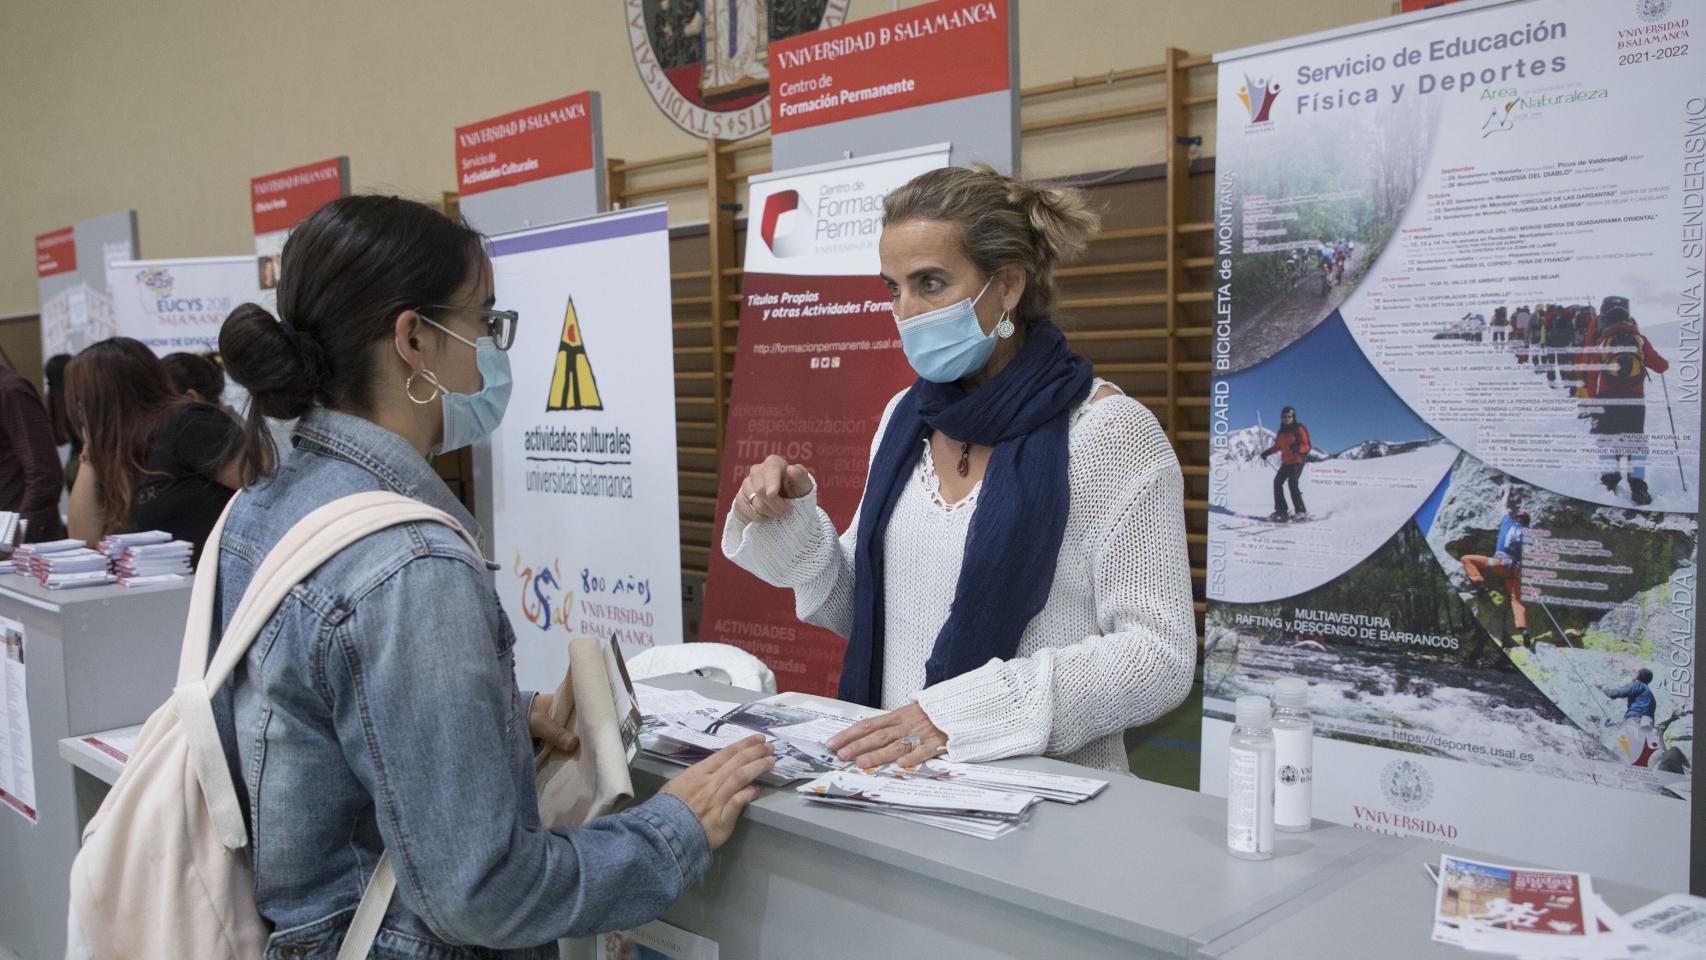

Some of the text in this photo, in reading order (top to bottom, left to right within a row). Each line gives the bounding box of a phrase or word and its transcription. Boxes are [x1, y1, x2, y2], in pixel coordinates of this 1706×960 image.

[894, 2, 996, 43] SALAMANCA
[1297, 19, 1567, 85] Servicio de Educación
[1619, 44, 1689, 66] 2021-2022
[779, 73, 833, 97] Centro de
[779, 78, 915, 117] Formación Permanente
[1297, 87, 1377, 114] Física
[1391, 83, 1404, 103] y
[1418, 56, 1567, 95] Deportes
[1520, 89, 1608, 109] Naturaleza
[527, 104, 586, 130] SALAMANCA
[462, 152, 496, 170] Servicio de
[463, 158, 539, 185] Actividades Culturales
[820, 181, 864, 196] Centro de
[1528, 172, 1541, 180] DEL
[1682, 97, 1706, 259] SENDERISMO
[1218, 260, 1232, 281] de
[156, 297, 203, 313] EUCYS
[748, 290, 820, 306] Títulos Propios
[762, 308, 770, 321] y
[772, 306, 800, 318] otras
[802, 302, 861, 317] Actividades
[1216, 280, 1232, 370] BICICLETA
[1676, 284, 1699, 404] MONTAÑA
[747, 416, 867, 436] especialización
[1651, 433, 1681, 441] NATURAL
[525, 425, 631, 455] actividades culturales
[737, 435, 814, 461] TÍTULOS
[1213, 380, 1230, 509] SNOWBOARD
[526, 464, 632, 499] universidad salamanca
[581, 568, 606, 594] 800
[714, 619, 797, 641] ACTIVIDADES
[1235, 613, 1459, 649] RAFTING y DESCENSO DE BARRANCOS
[1295, 607, 1391, 629] MULTIAVENTURA
[1671, 573, 1693, 697] ESCALADA
[1392, 729, 1535, 762] https://deportes.usal.es
